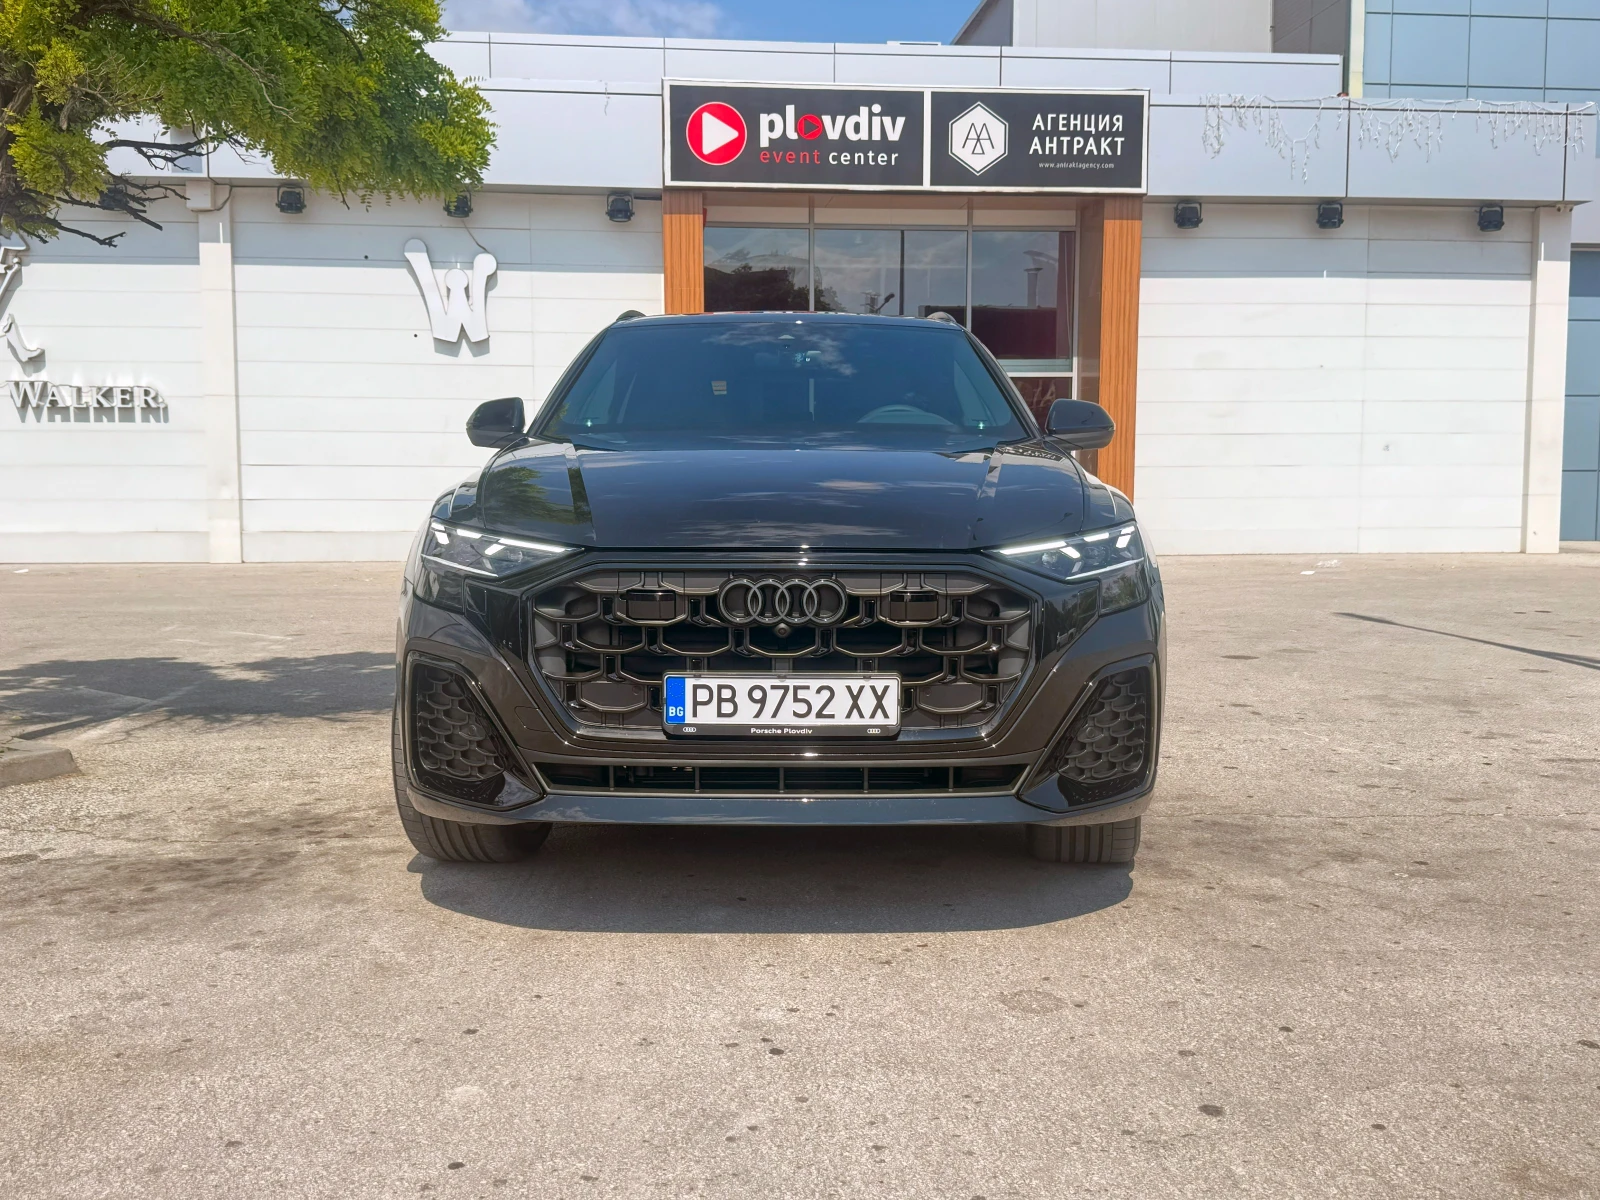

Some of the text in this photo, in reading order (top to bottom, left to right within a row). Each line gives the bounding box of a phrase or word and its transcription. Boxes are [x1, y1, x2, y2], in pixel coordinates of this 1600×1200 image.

[1032, 113, 1123, 134] АГЕНЦИЯ
[1029, 136, 1125, 156] АНТРАКТ
[760, 150, 898, 165] event center
[1038, 161, 1115, 170] www.antraktagency.com
[692, 684, 890, 719] PB 9752 XX
[669, 706, 684, 717] BG
[783, 727, 813, 735] Plovdiv
